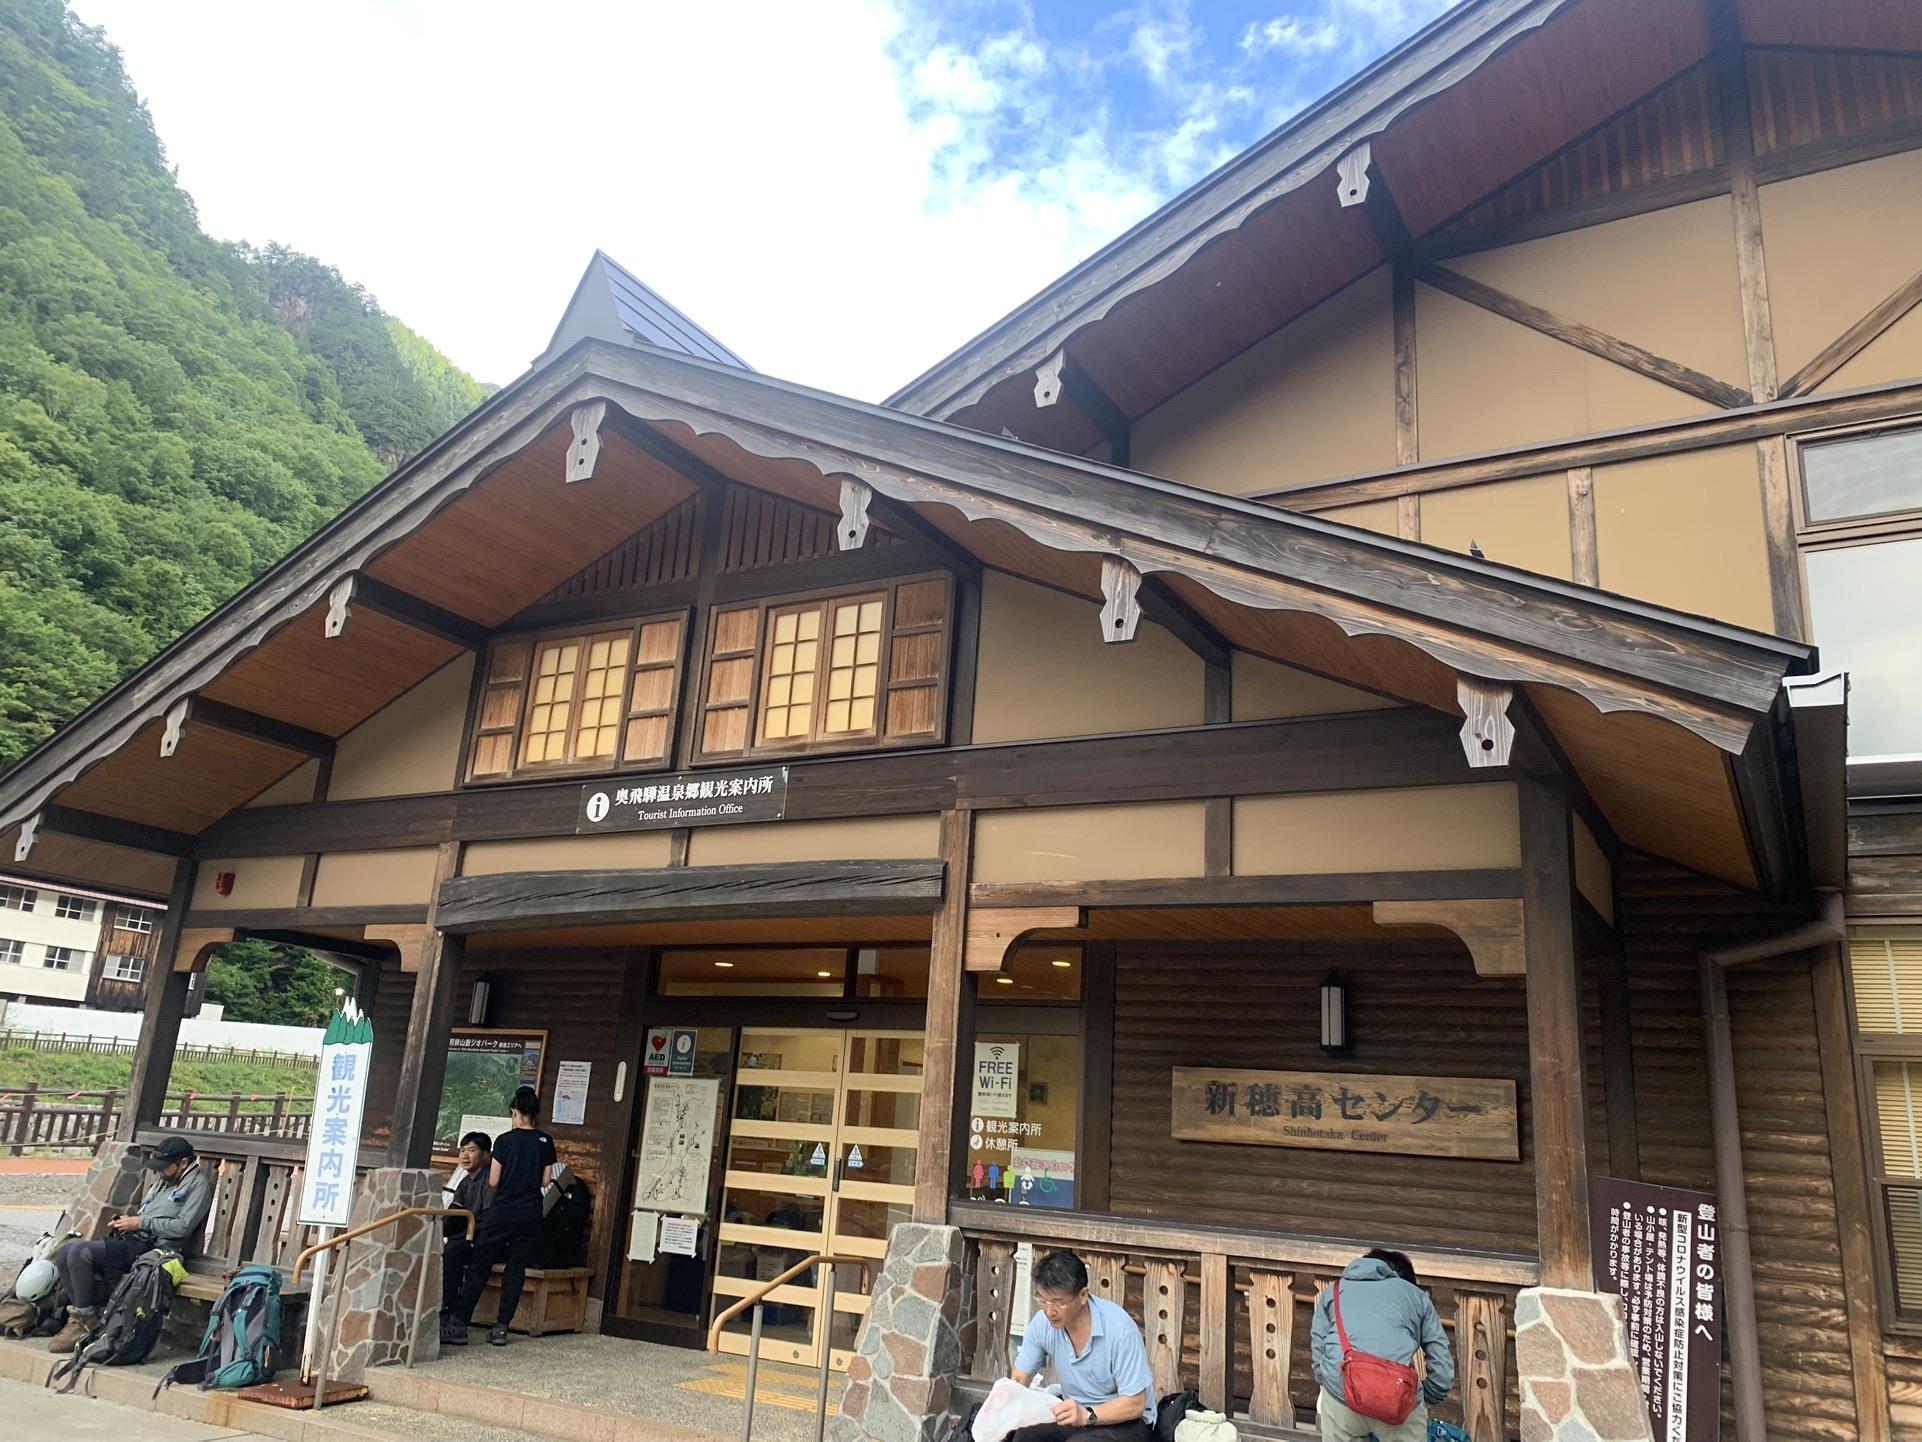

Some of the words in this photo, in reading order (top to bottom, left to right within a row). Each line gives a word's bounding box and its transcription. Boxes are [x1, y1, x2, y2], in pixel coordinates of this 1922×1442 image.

[638, 808, 667, 821] Tourist
[669, 805, 716, 818] Information
[718, 803, 743, 814] Office
[648, 1053, 666, 1061] AED
[979, 1061, 1013, 1075] FREE
[979, 1076, 1012, 1089] Wi-Fi
[1204, 1080, 1482, 1125] 新穂高センター
[312, 1053, 357, 1212] 観光案内所
[986, 1119, 1042, 1137] 観光案内所
[1282, 1125, 1344, 1141] Shinhotaka
[1350, 1126, 1389, 1143] Center
[985, 1137, 1019, 1152] 休憩所
[1694, 1203, 1716, 1342] 登山者の皆様へ
